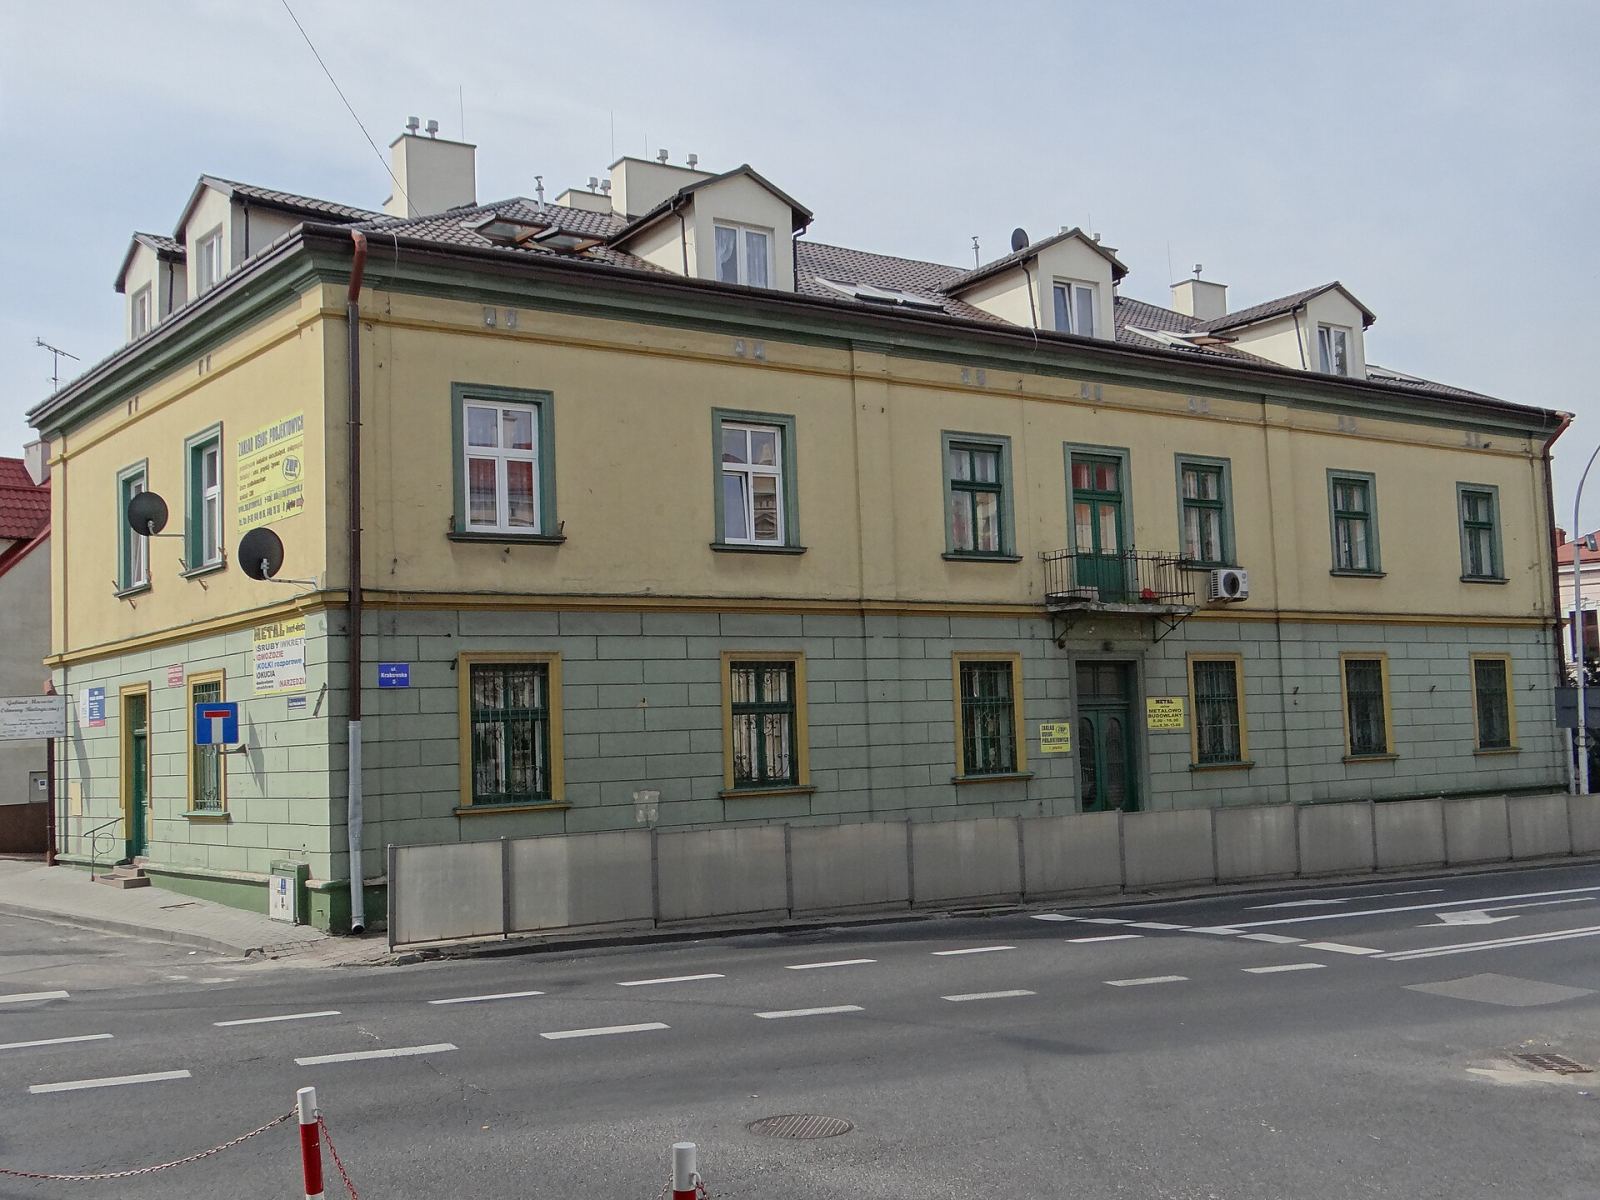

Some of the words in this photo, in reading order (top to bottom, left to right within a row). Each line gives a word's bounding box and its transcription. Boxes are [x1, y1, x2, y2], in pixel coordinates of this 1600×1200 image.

[254, 623, 285, 641] METAL
[274, 658, 303, 668] rozporowe
[256, 670, 276, 679] OKUCIA
